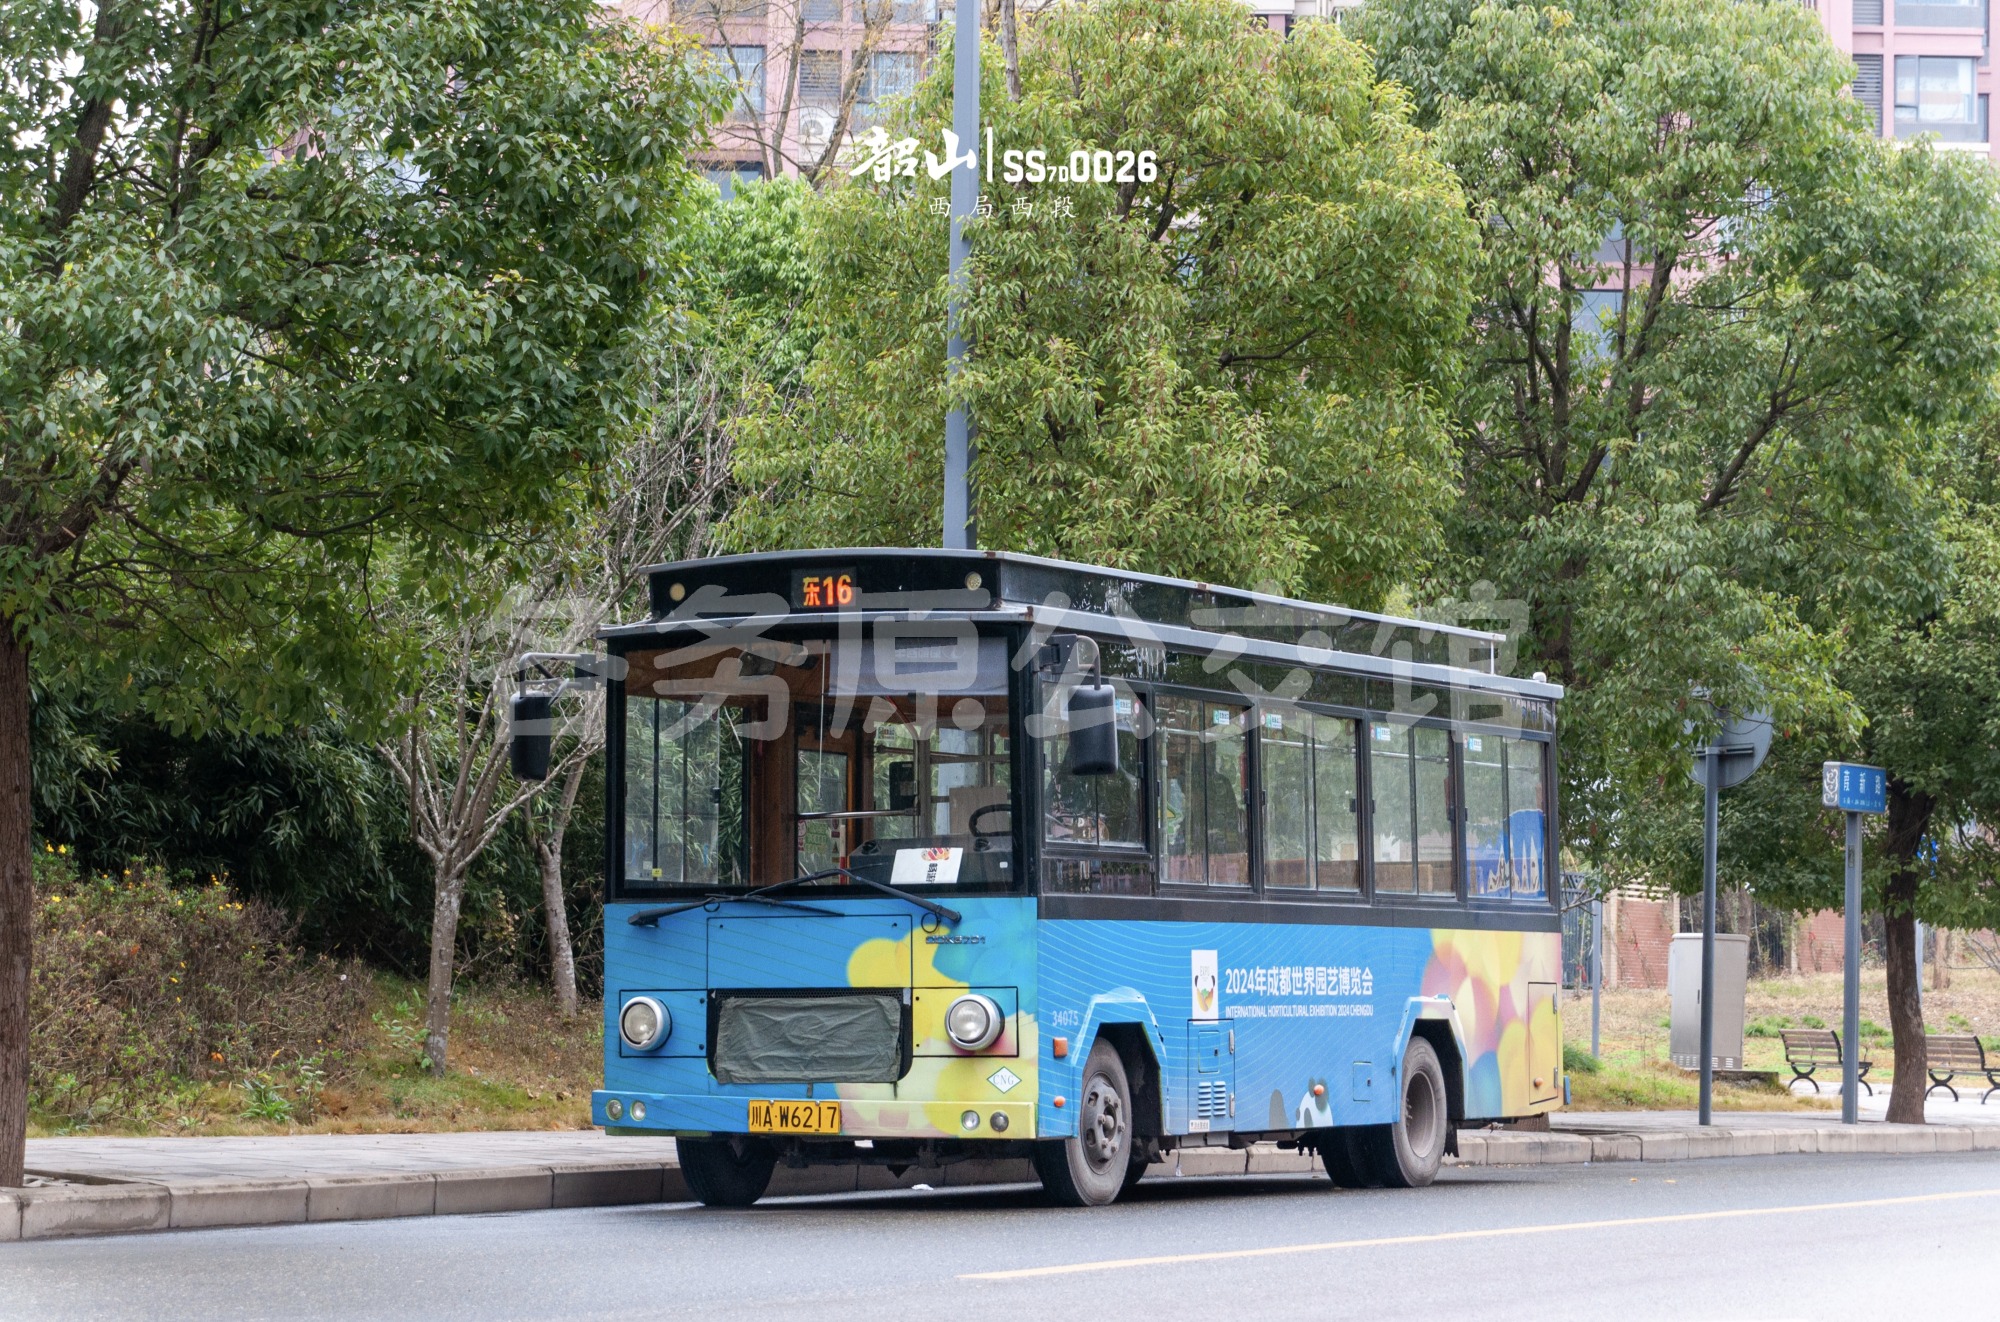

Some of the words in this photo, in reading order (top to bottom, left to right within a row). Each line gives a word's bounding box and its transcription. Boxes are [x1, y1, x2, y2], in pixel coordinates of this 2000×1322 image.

[803, 575, 852, 606] 东16
[1225, 965, 1374, 996] 2024年成都世界园艺博览会
[1052, 1010, 1079, 1026] 34075
[1225, 1005, 1267, 1018] INTERNATIONAL
[1268, 1005, 1308, 1017] HORTICULTURAL
[1310, 1005, 1337, 1016] EXHIBITION
[1338, 1004, 1349, 1016] 2024
[1350, 1004, 1374, 1016] CHENGDU
[993, 1074, 1014, 1085] CNG
